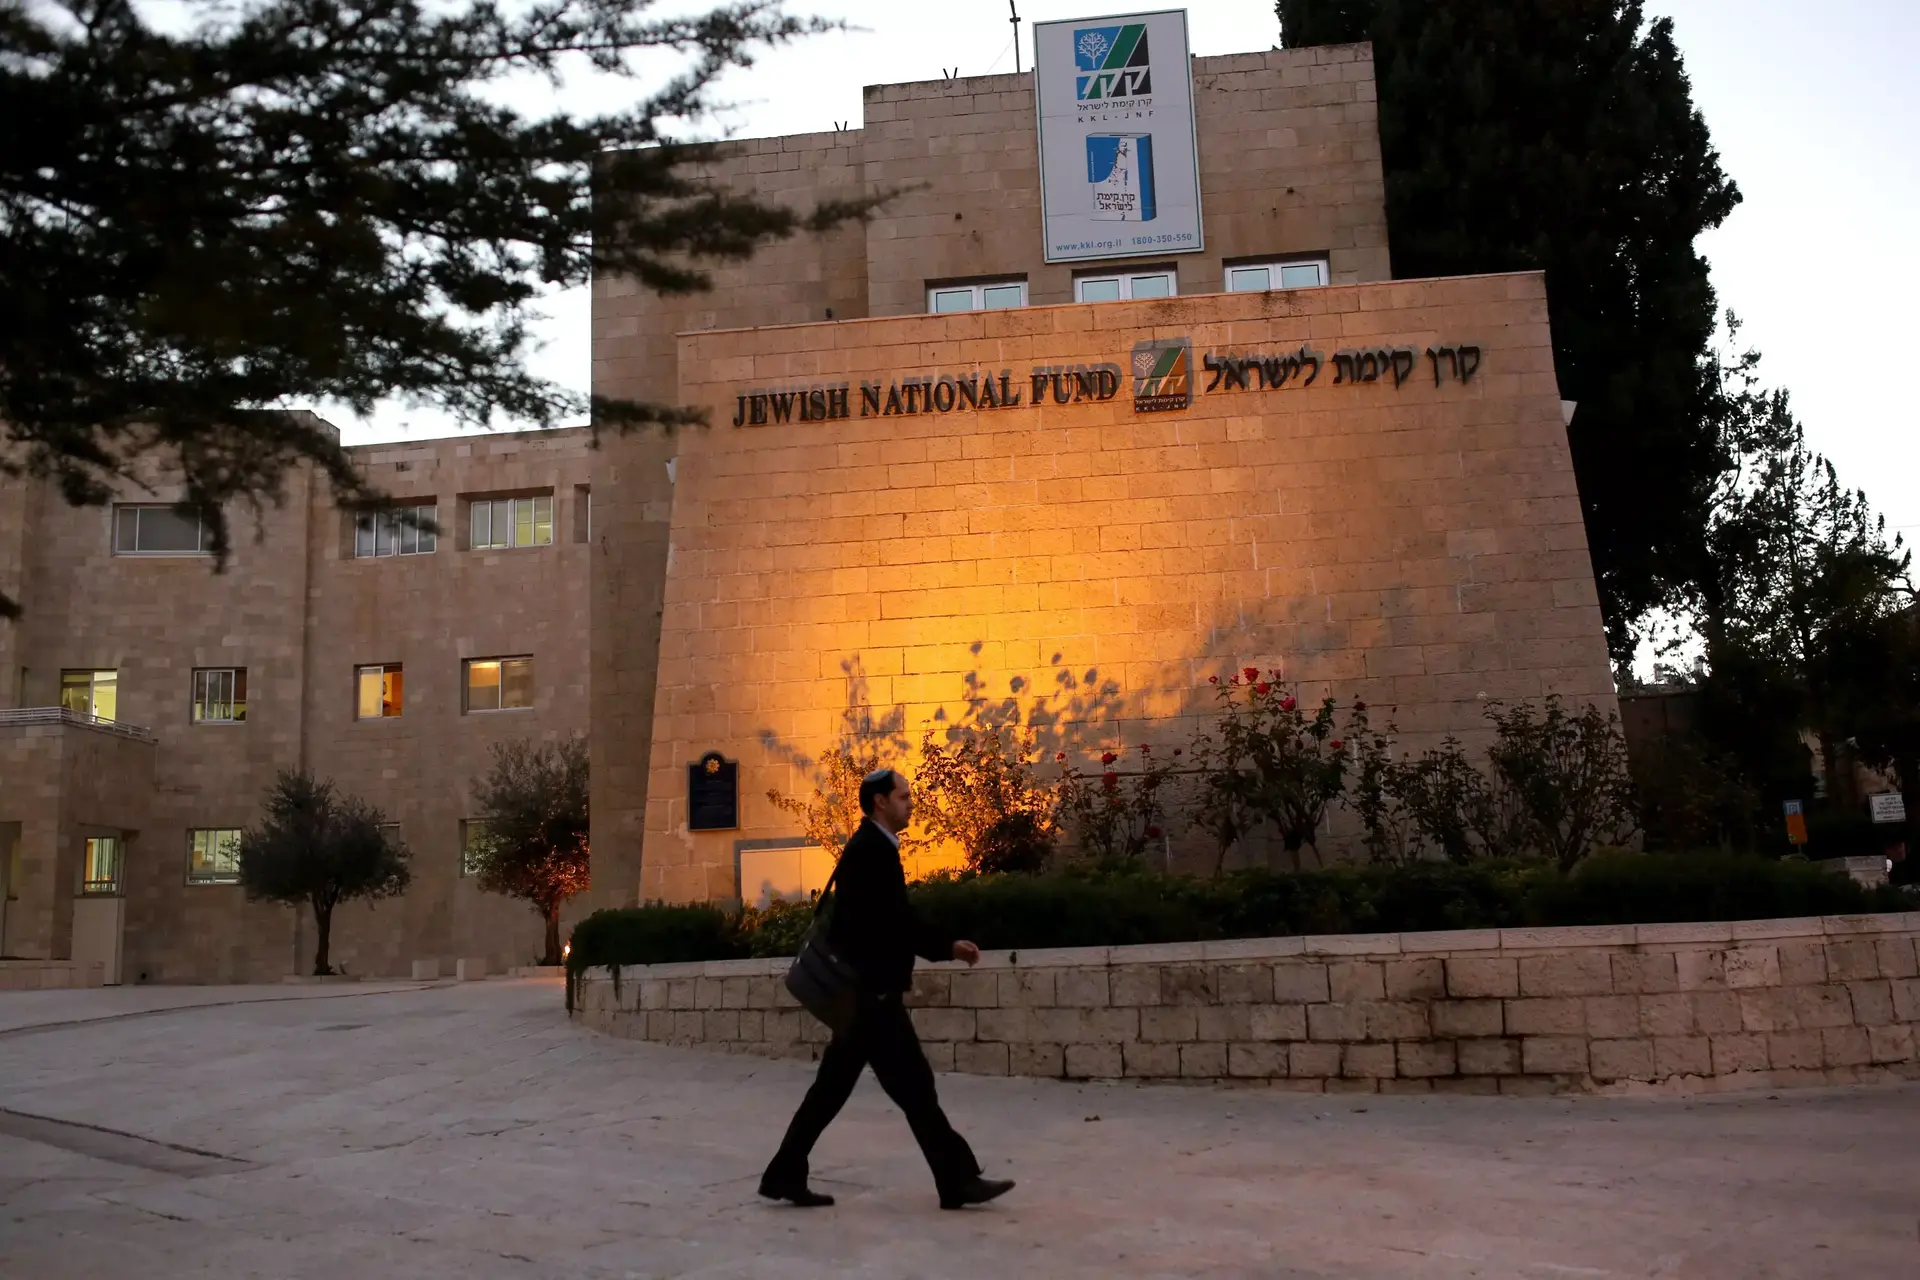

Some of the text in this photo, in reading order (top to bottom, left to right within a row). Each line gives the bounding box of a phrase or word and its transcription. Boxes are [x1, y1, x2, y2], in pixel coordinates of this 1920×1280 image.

[1076, 98, 1153, 111] קרן קימת לישראל
[1096, 192, 1136, 201] קרן קימת
[1099, 201, 1133, 211] לישראל
[1055, 233, 1192, 251] www.kkl.org.il 1800-350-550
[1203, 345, 1481, 393] קרן קימת לישראל
[733, 370, 1118, 427] JEWISH NATIONAL FUND
